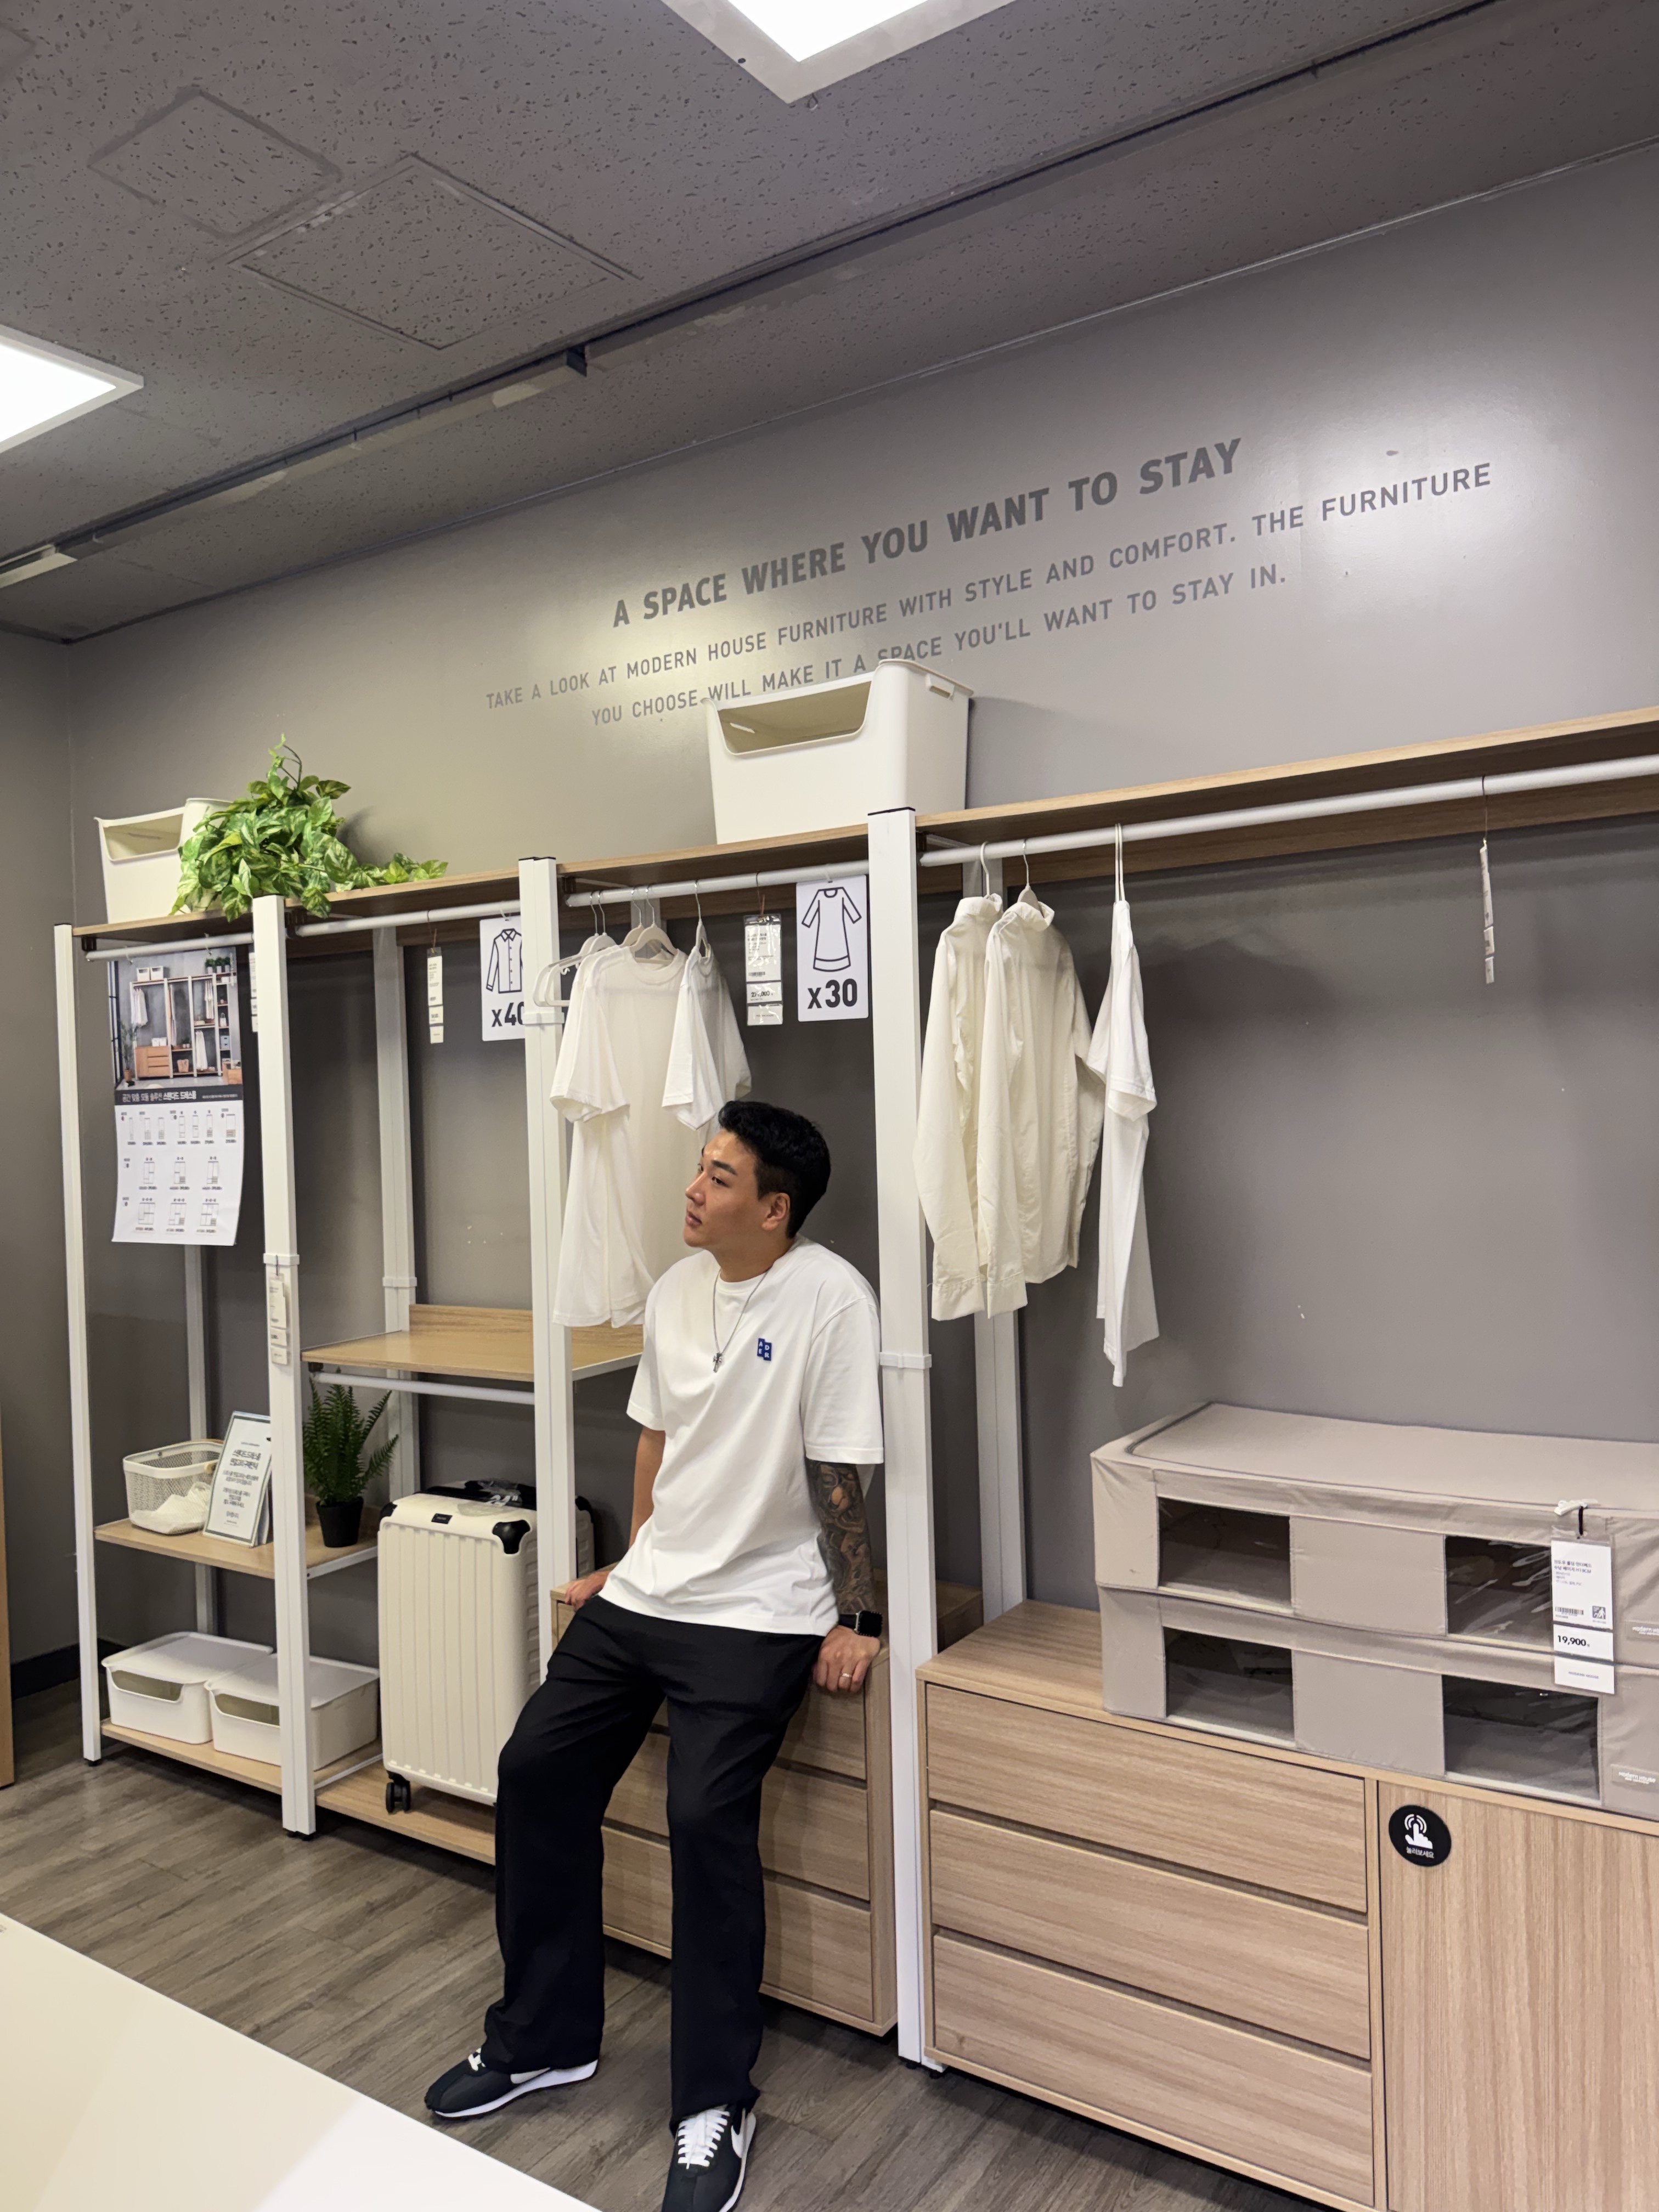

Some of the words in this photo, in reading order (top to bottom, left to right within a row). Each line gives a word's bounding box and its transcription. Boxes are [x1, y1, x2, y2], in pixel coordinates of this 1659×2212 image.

[486, 687, 523, 708] TAKE
[532, 685, 541, 699] A
[550, 672, 589, 696] LOOK
[599, 666, 617, 684] AT
[627, 648, 697, 679] MODERN
[708, 633, 767, 661] HOUSE
[778, 603, 887, 645] FURNITURE
[899, 589, 952, 618] WITH
[964, 569, 1033, 602] STYLE
[1046, 555, 1094, 584] AND
[1109, 523, 1236, 568] COMFORT.
[1251, 506, 1304, 537] THE
[1322, 462, 1491, 521] FURNITURE
[613, 600, 630, 627] A
[644, 573, 727, 620] SPACE
[742, 542, 846, 594] WHERE
[861, 518, 928, 563] YOU
[947, 488, 1050, 543] WANT
[1068, 471, 1119, 511] TO
[1139, 438, 1242, 495] STAY
[591, 706, 622, 726] YOU
[632, 690, 698, 718] CHOOSE
[708, 680, 752, 701] WILL
[762, 664, 814, 692] MAKE
[825, 658, 842, 679] IT
[854, 654, 866, 671] A
[879, 637, 943, 661] SPACE
[955, 618, 1031, 651] YOU'LL
[1044, 599, 1113, 632] WANT
[1127, 591, 1157, 614] TO
[1171, 572, 1234, 605] STAY
[1250, 563, 1286, 587] IN.
[807, 978, 857, 1009] x30
[1558, 1635, 1586, 1646] 19,900
